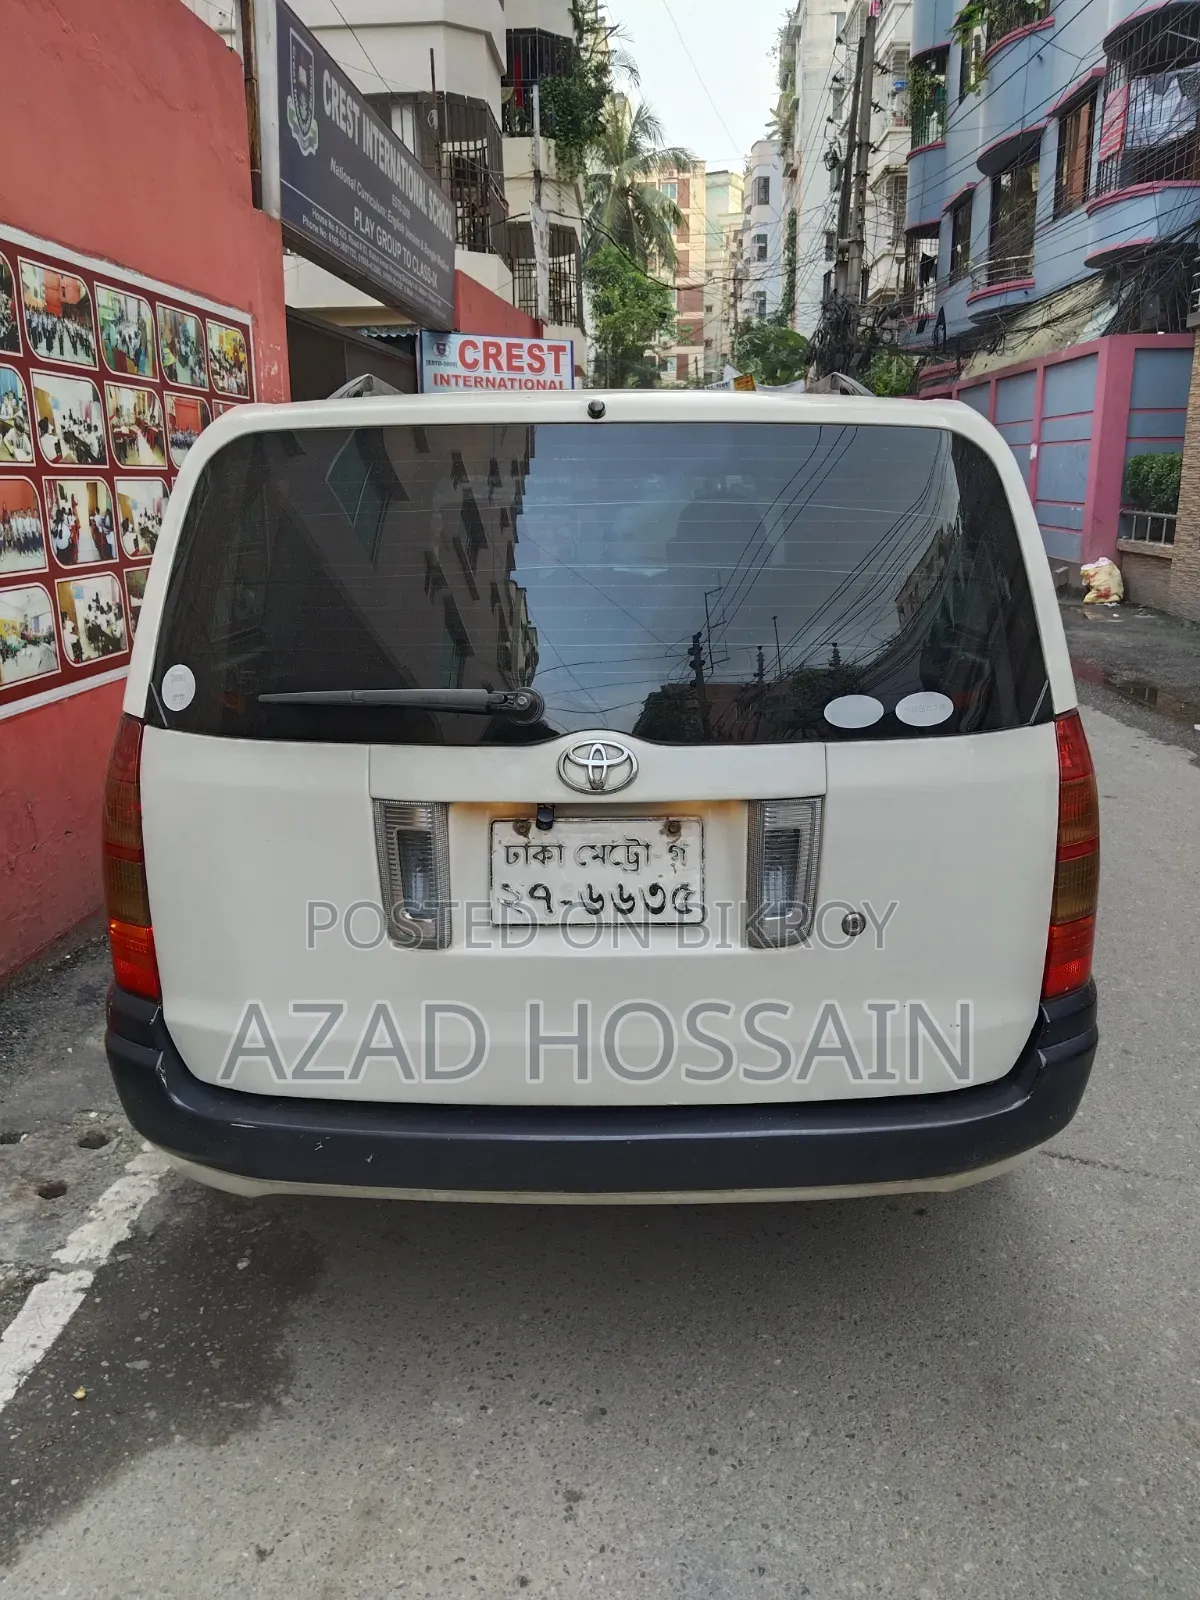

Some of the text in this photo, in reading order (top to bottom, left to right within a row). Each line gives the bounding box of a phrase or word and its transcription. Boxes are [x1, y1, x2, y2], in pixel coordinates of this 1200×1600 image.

[323, 69, 360, 145] CREST
[362, 112, 428, 216] INTERNATIONAL
[428, 188, 453, 242] SCHOOL
[330, 157, 356, 191] National
[387, 209, 405, 234] English
[302, 214, 319, 234] Phone
[311, 207, 328, 227] House
[353, 206, 375, 241] PLAY
[376, 225, 402, 260] GROUP
[402, 246, 412, 269] TO
[458, 339, 567, 376] CREST
[433, 372, 564, 390] INTERNATIONAL
[504, 841, 564, 866] ঢাকা
